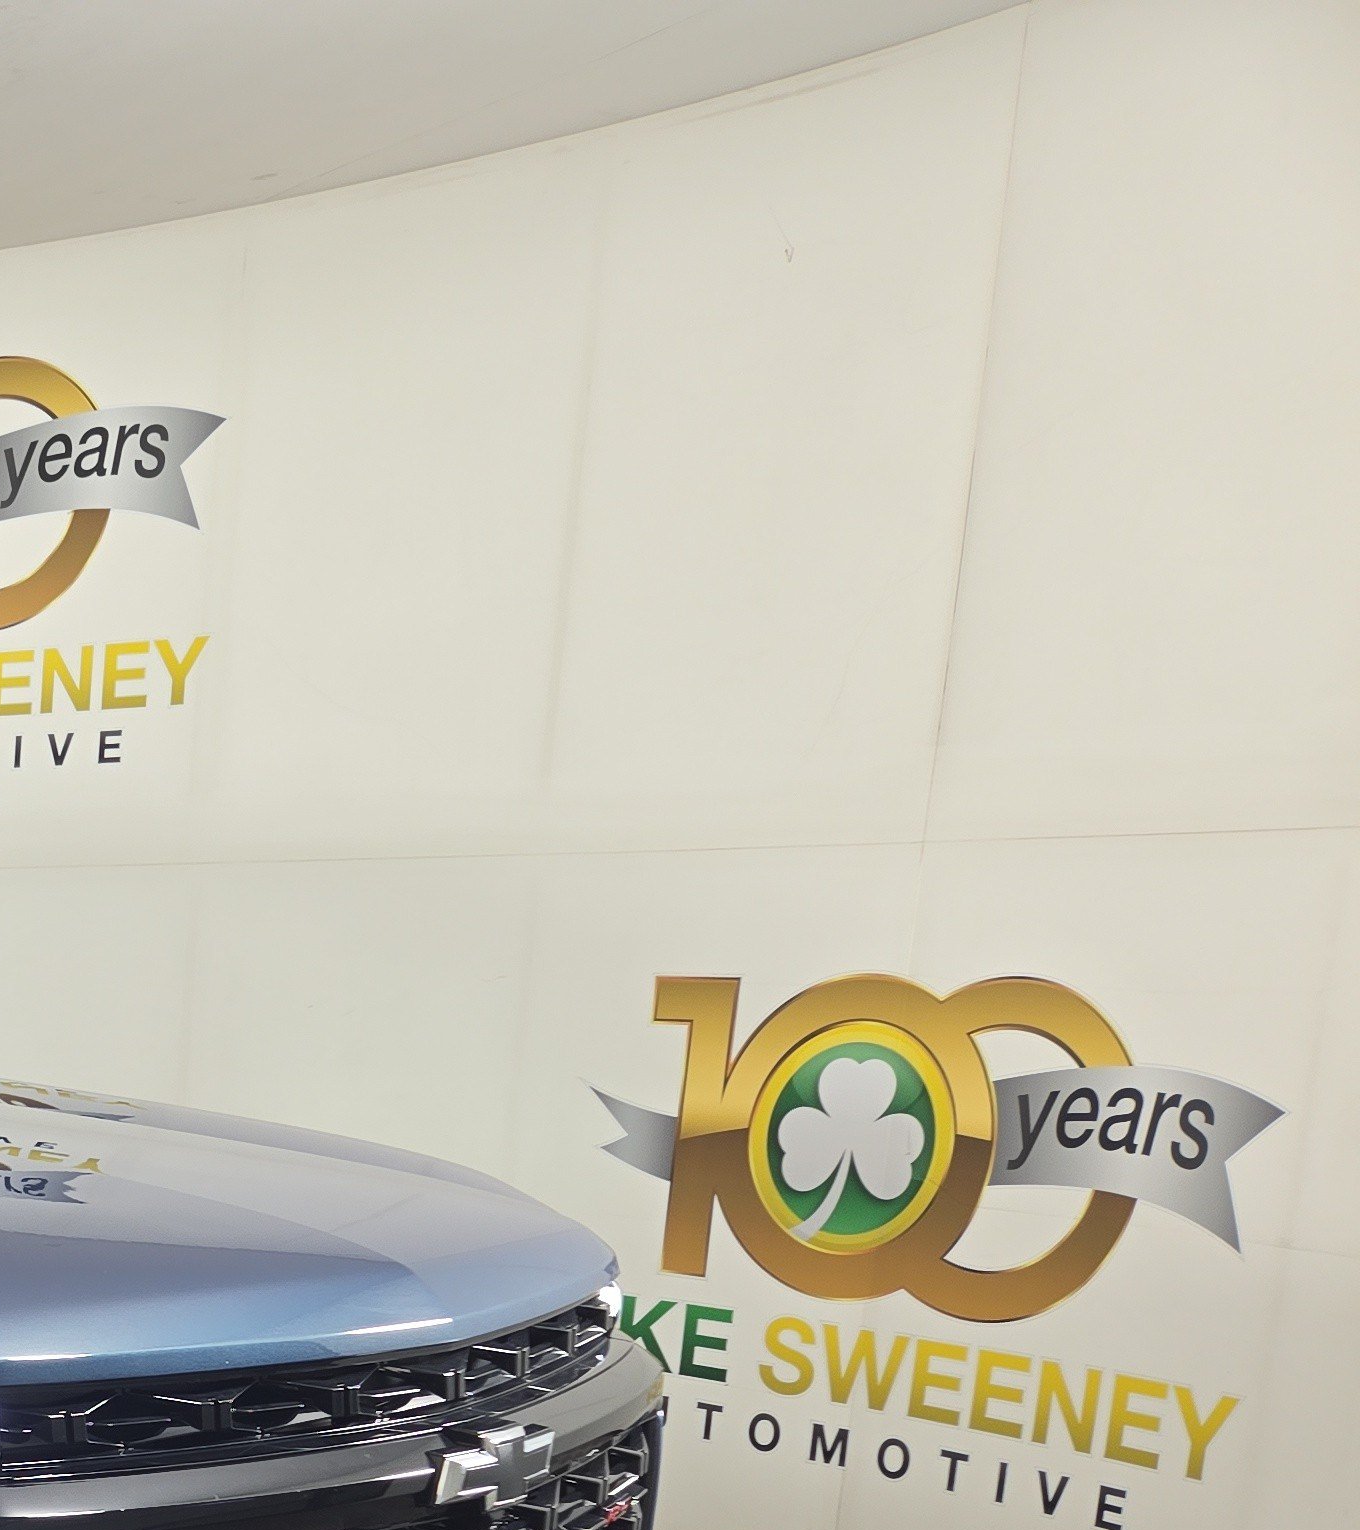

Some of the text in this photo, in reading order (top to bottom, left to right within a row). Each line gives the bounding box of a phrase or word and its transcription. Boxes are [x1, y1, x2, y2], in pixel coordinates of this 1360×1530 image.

[0, 422, 169, 509] years
[1006, 1086, 1215, 1170] years
[758, 1316, 1240, 1481] SWEENEY
